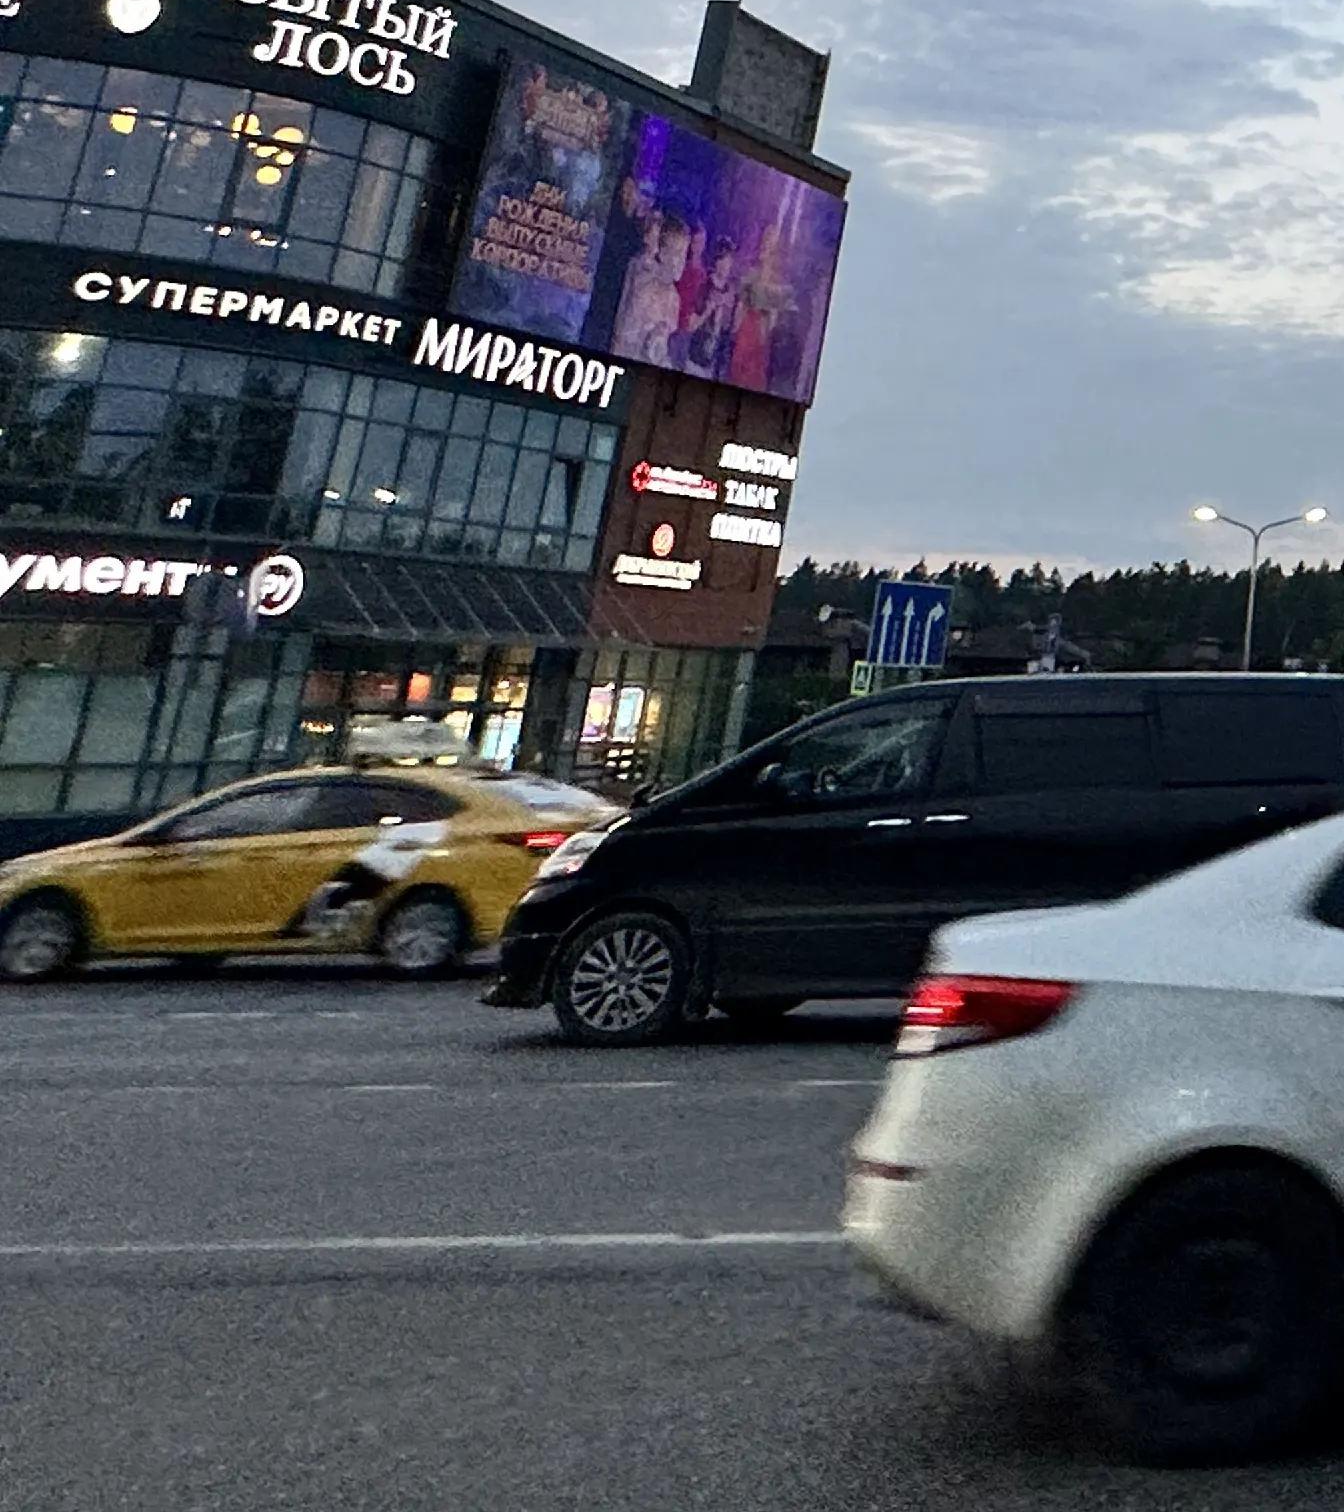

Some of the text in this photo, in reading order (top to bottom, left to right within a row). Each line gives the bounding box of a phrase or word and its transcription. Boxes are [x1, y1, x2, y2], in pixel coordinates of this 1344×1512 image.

[251, 19, 416, 96] ЛОСЬ
[73, 271, 625, 409] СУПЕРМАРКЕТ МИРАТОРГ
[725, 479, 779, 510] ТАБАК
